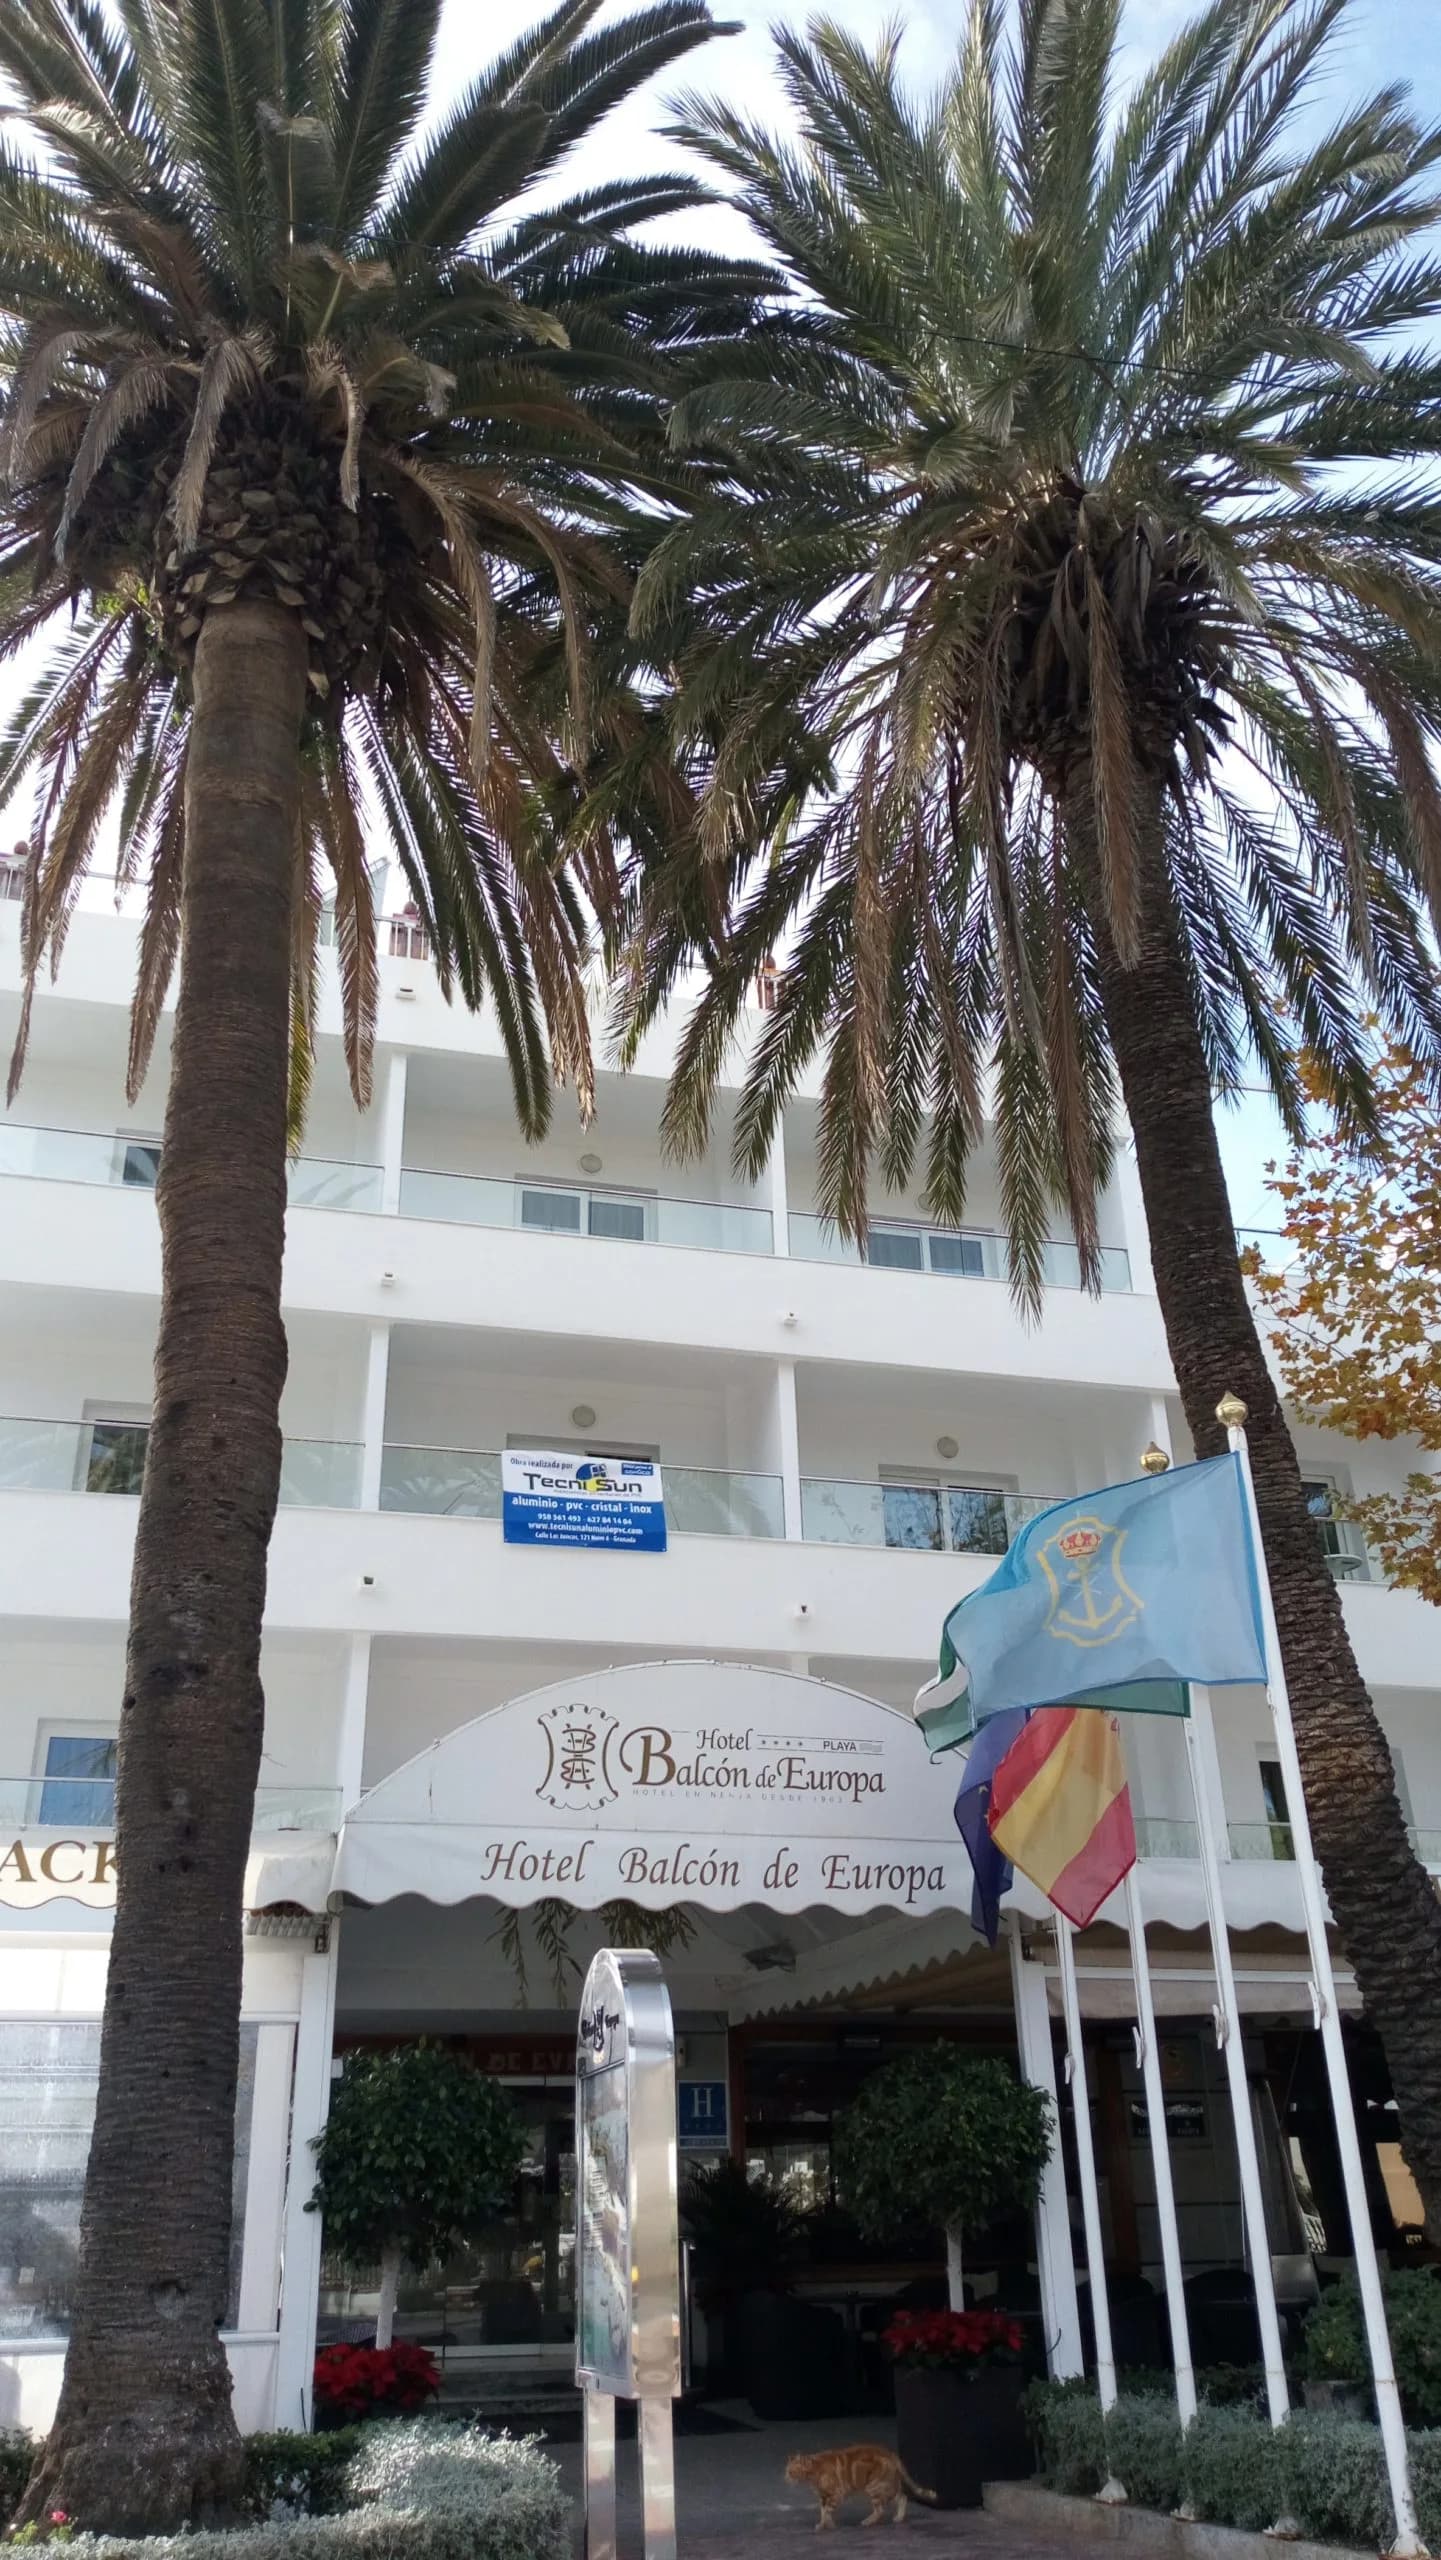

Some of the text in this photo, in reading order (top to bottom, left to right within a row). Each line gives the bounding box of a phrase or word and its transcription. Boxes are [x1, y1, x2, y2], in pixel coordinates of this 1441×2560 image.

[528, 1460, 560, 1468] realizada
[512, 1495, 558, 1509] aluminio
[566, 1502, 583, 1511] pvc
[591, 1501, 622, 1512] cristal
[630, 1503, 652, 1513] inox
[696, 1728, 754, 1751] Hotel
[823, 1741, 857, 1751] PLAYA
[619, 1726, 886, 1803] Balcón de Europa
[632, 1789, 675, 1797] HOTEL
[480, 1840, 946, 1904] Hotel Balcón de Europa
[690, 2087, 715, 2118] H
